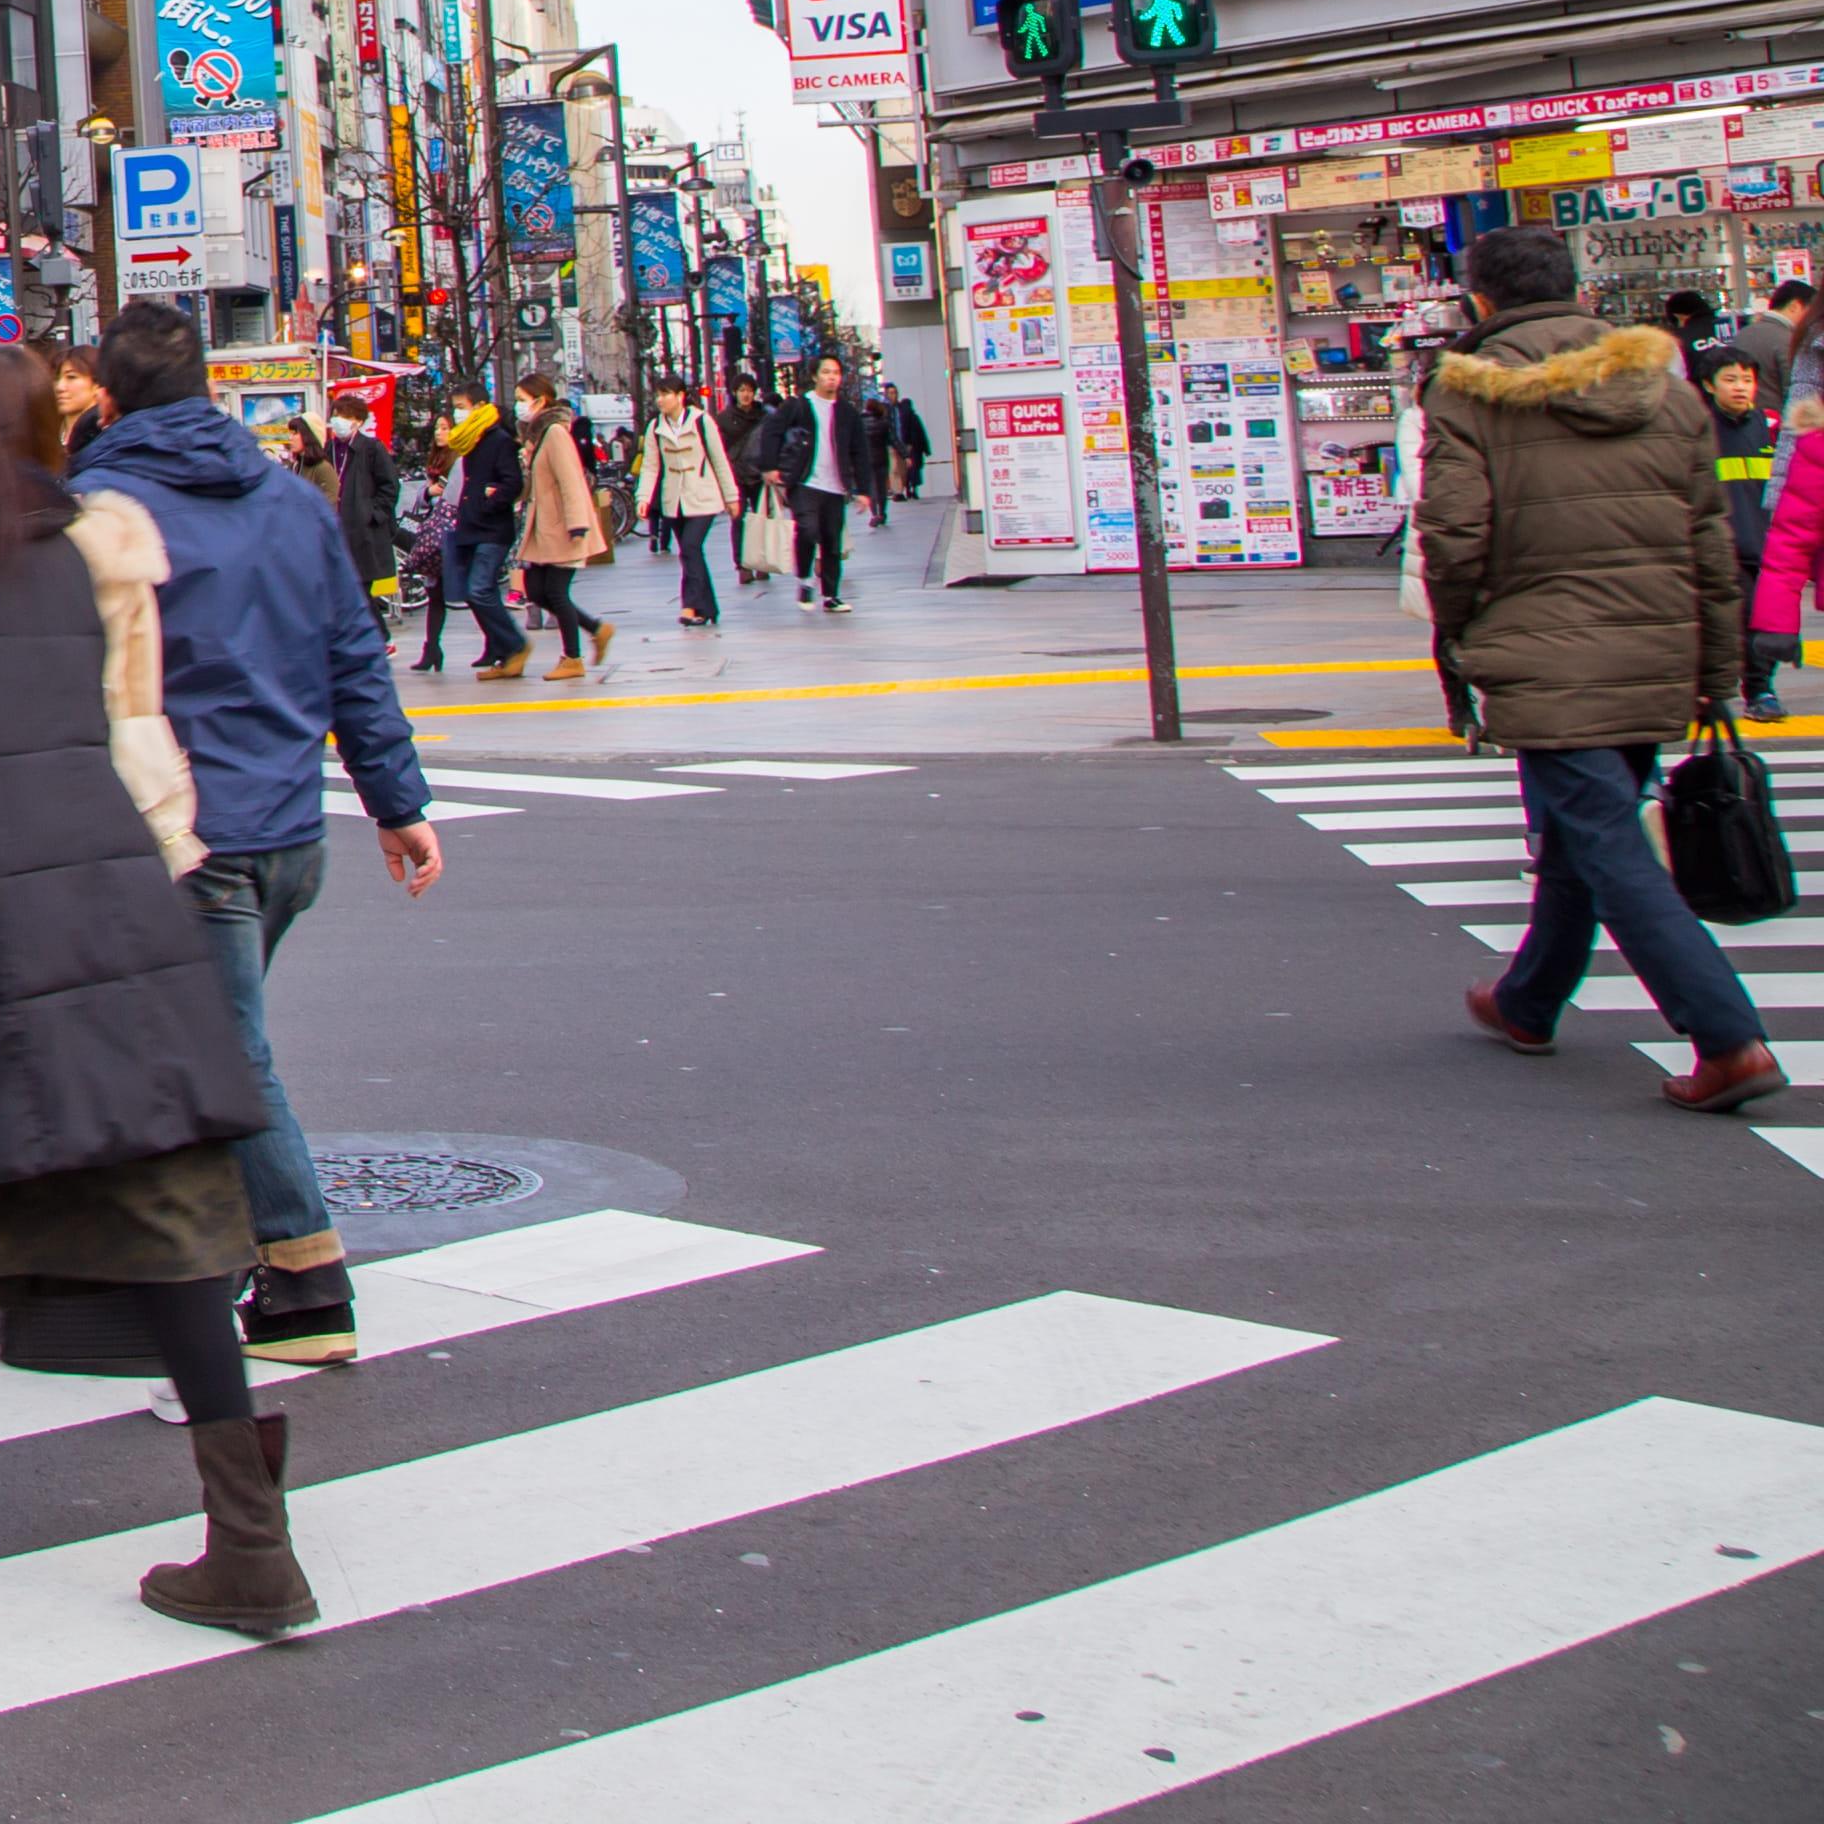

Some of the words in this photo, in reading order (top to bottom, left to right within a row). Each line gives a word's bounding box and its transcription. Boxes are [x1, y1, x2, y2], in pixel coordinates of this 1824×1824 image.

[359, 1, 376, 47] ガスト
[802, 11, 893, 43] VISA
[793, 75, 825, 91] BIC
[828, 69, 907, 88] CAMERA
[1530, 98, 1590, 120] QUICK
[1593, 88, 1670, 113] TaxFree
[170, 112, 276, 133] 新宿区内全域
[1387, 120, 1415, 138] BIC
[1414, 108, 1482, 134] CAMERA
[123, 153, 191, 231] P
[1255, 193, 1284, 206] VISA
[1012, 403, 1058, 419] QUICK
